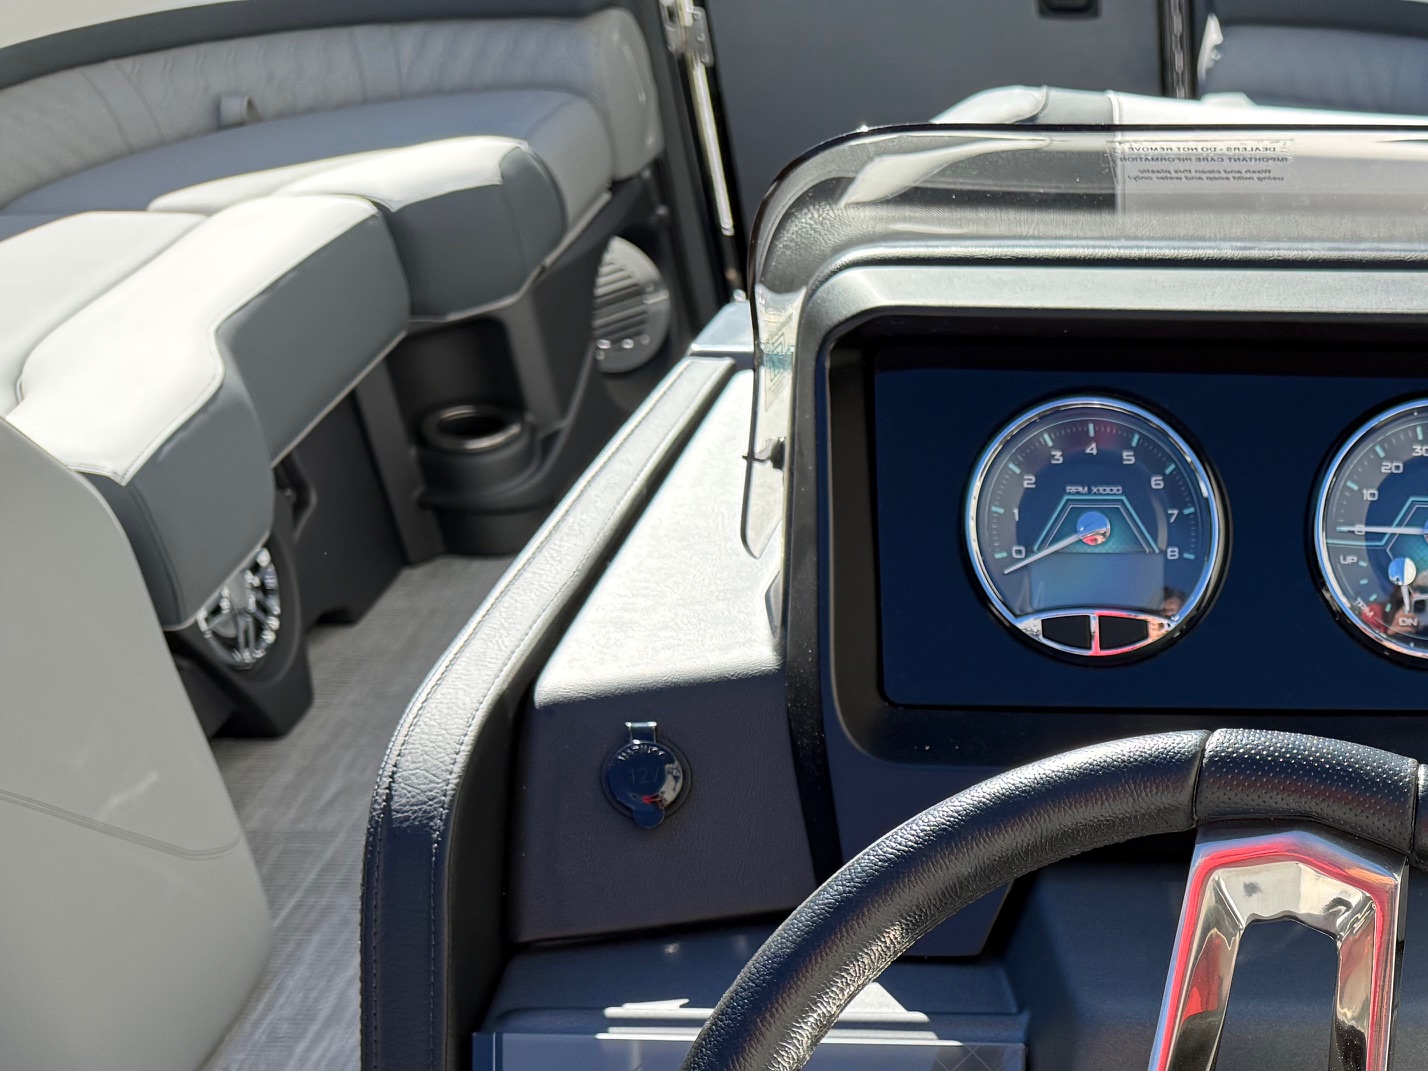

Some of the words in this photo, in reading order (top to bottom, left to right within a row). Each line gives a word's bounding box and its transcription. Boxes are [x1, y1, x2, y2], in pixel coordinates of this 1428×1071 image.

[1085, 443, 1098, 456] 4
[1050, 452, 1064, 465] 3
[1122, 452, 1136, 465] 5
[1380, 462, 1403, 474] 20
[1023, 476, 1036, 488] 2
[1151, 477, 1164, 489] 6
[1065, 486, 1089, 495] RPM
[1091, 486, 1123, 495] X1000
[1362, 489, 1379, 501] 10
[1012, 509, 1020, 521] 1
[1168, 510, 1179, 523] 7
[1011, 546, 1026, 559] 0
[1166, 548, 1180, 560] 8
[1339, 556, 1358, 565] UP
[1398, 617, 1418, 627] DN
